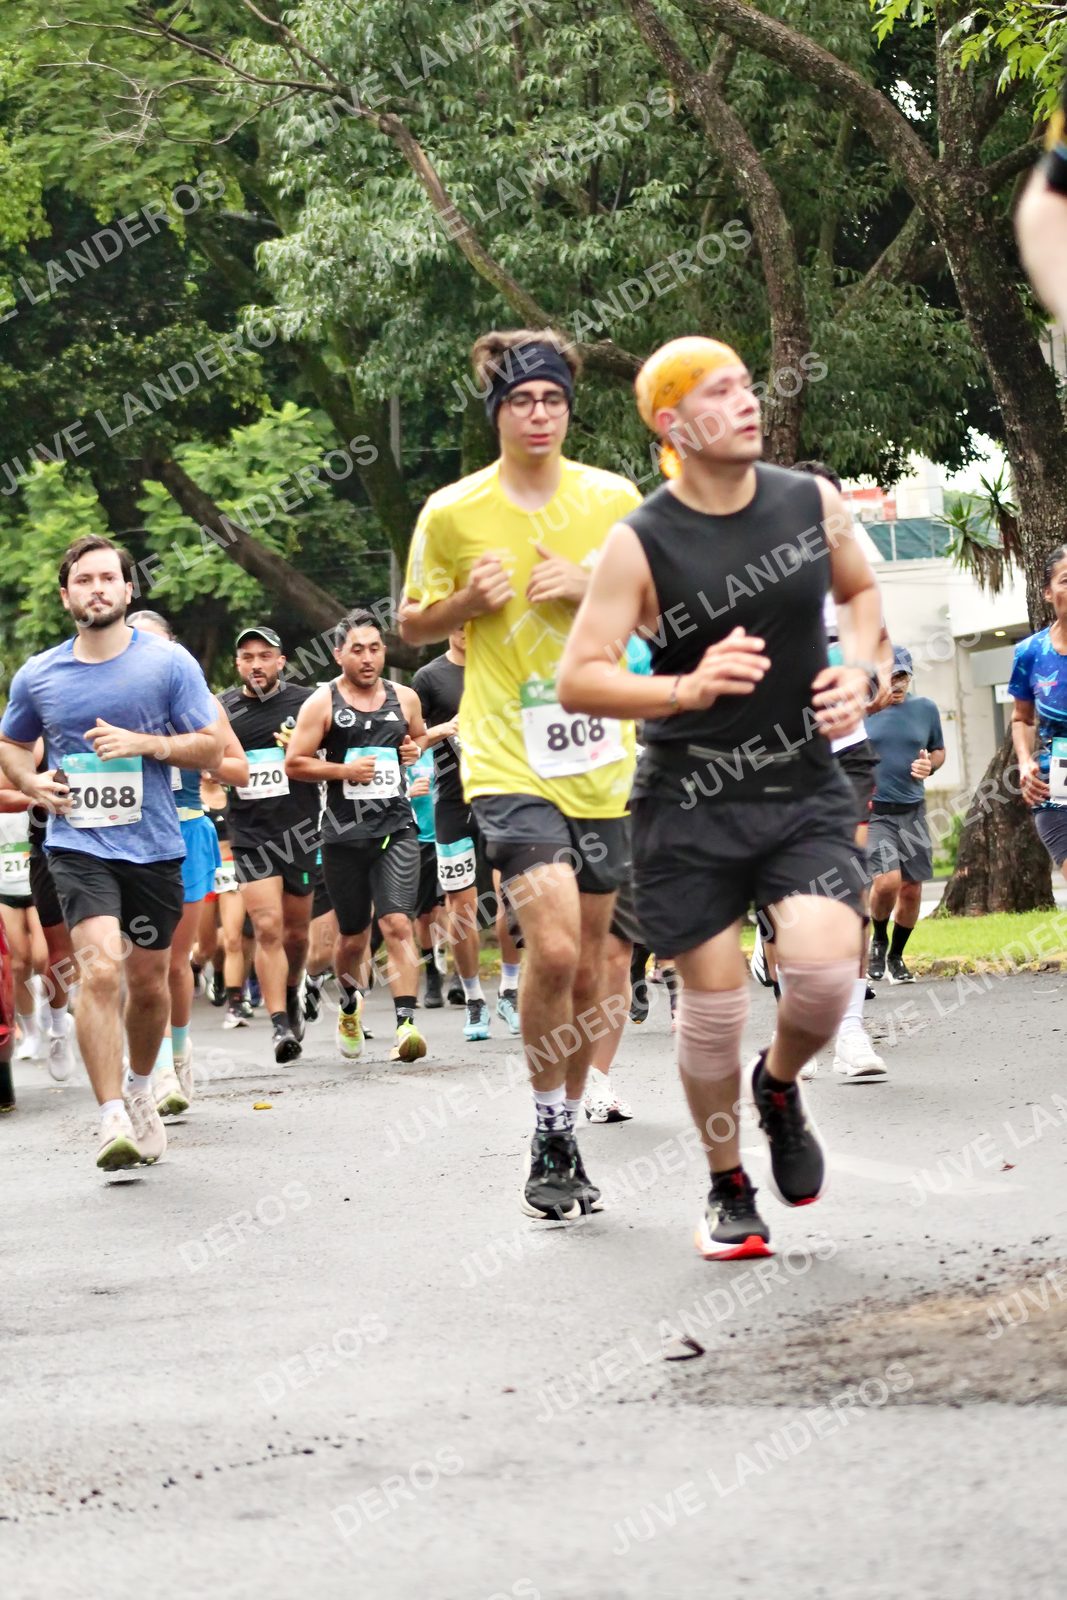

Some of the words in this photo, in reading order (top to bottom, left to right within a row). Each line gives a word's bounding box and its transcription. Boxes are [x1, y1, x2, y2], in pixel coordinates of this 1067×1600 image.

[547, 715, 605, 751] 808
[347, 770, 396, 787] 65
[69, 785, 137, 810] 3088
